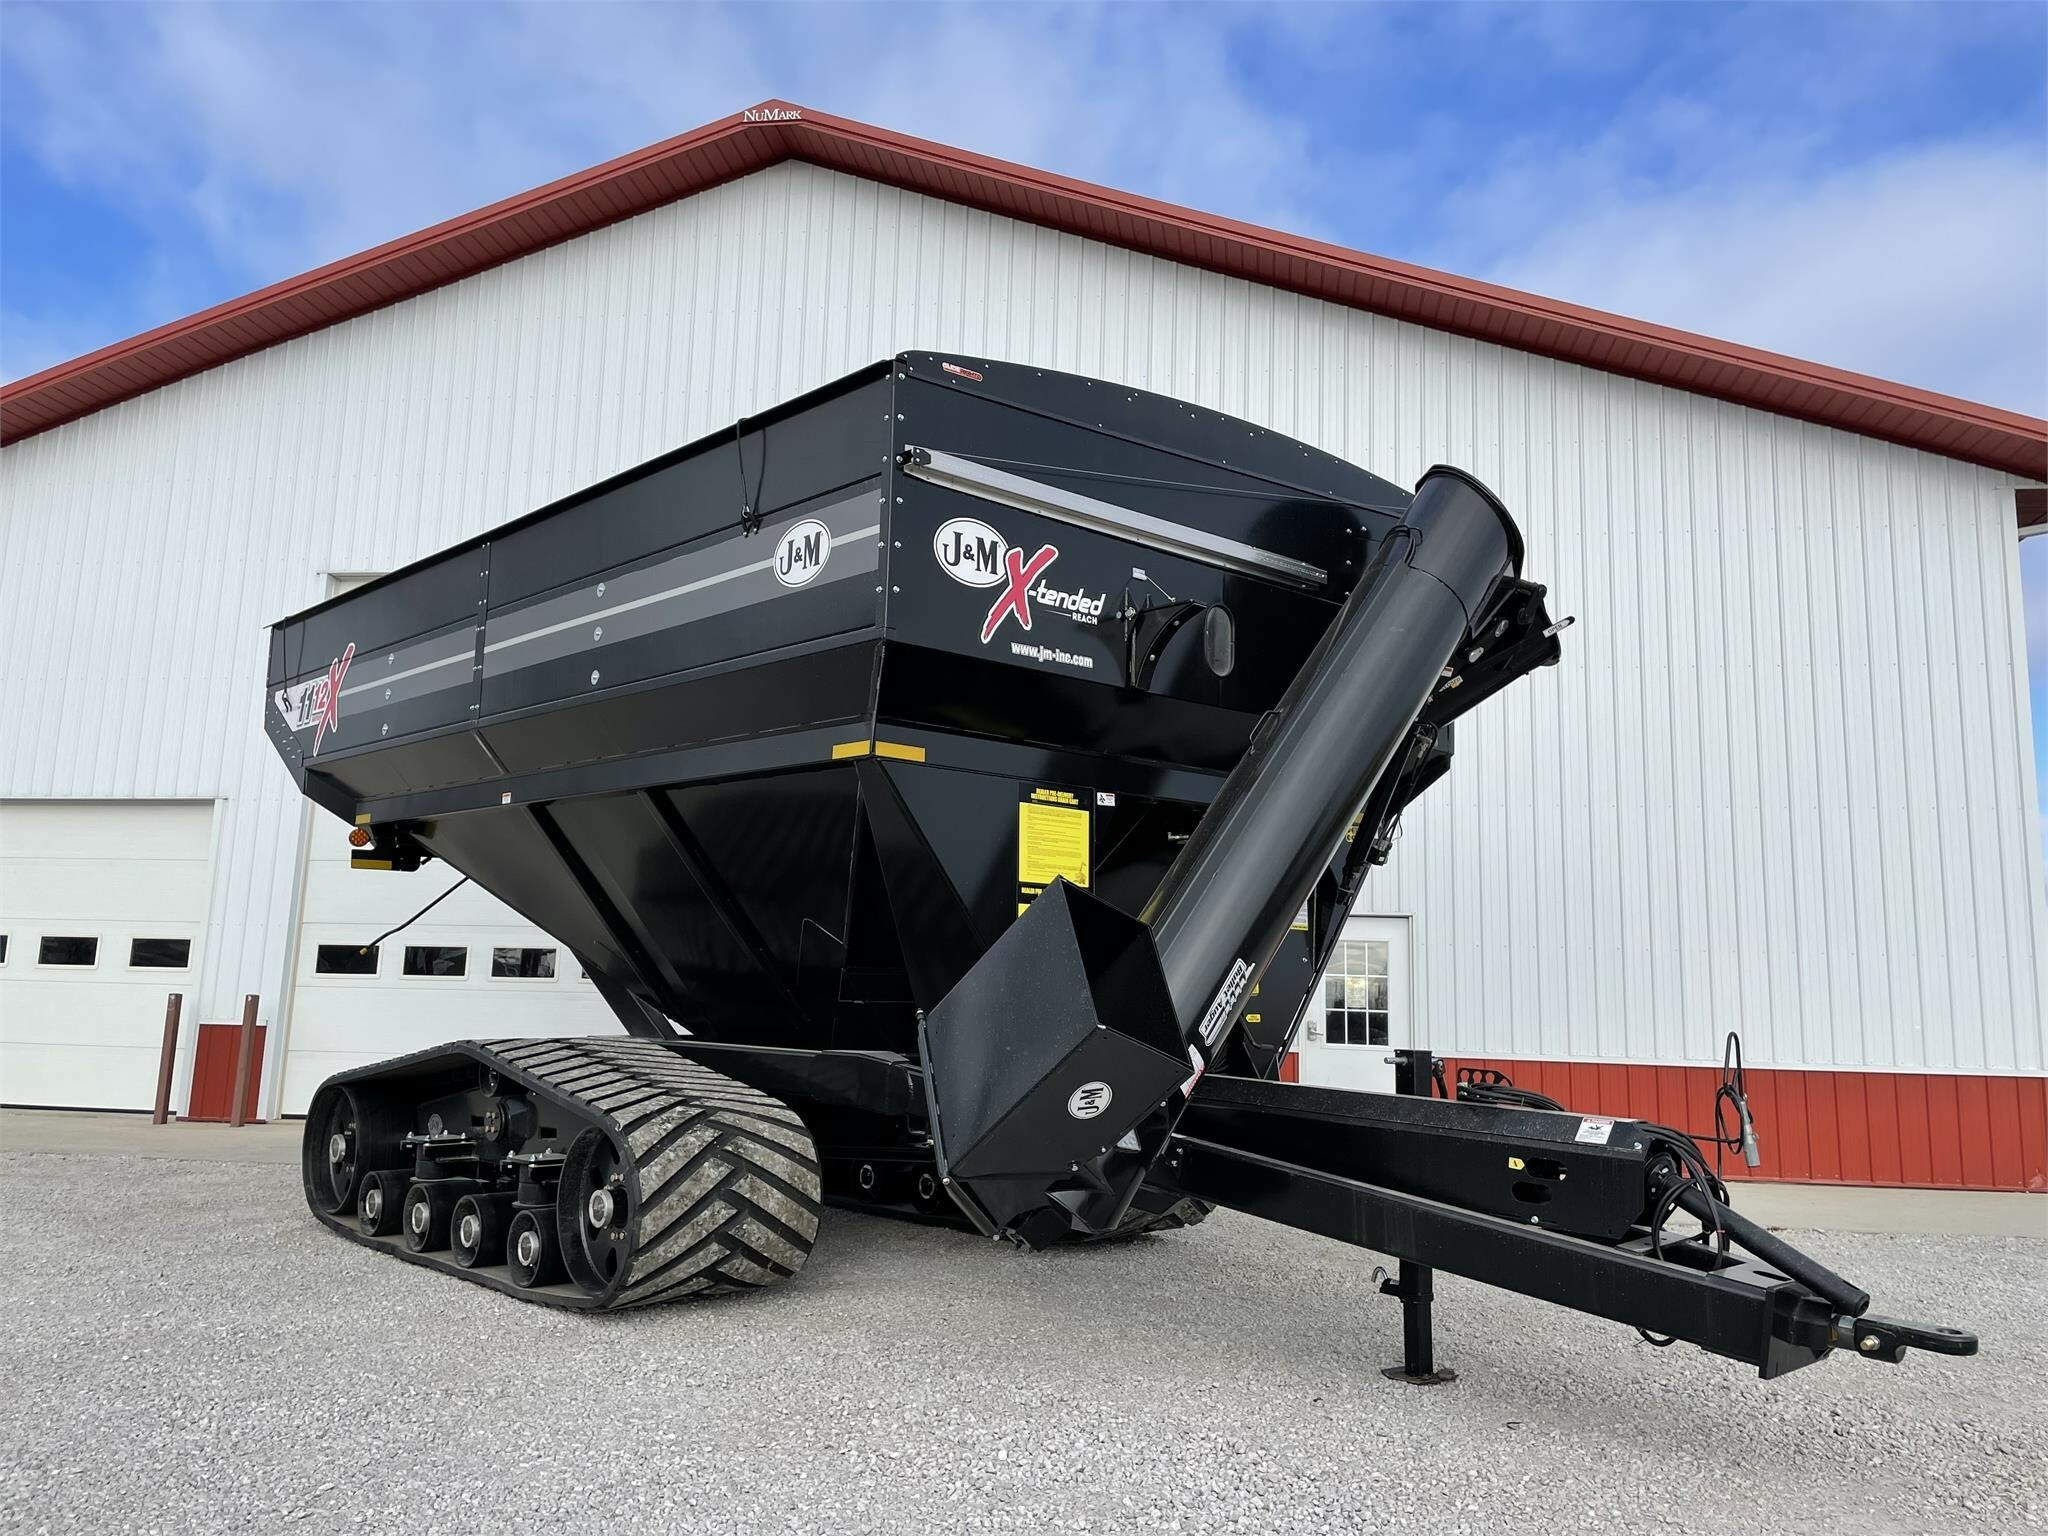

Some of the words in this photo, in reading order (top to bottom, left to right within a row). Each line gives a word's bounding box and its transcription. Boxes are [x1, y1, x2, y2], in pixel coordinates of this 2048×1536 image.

[780, 531, 822, 576] J&M
[942, 531, 999, 576] J&M
[1072, 612, 1098, 625] REACH
[1011, 642, 1093, 668] www.jm-inc.com
[1223, 965, 1243, 998] Bullet
[1203, 1000, 1223, 1033] Auger
[1077, 1087, 1104, 1114] J&M
